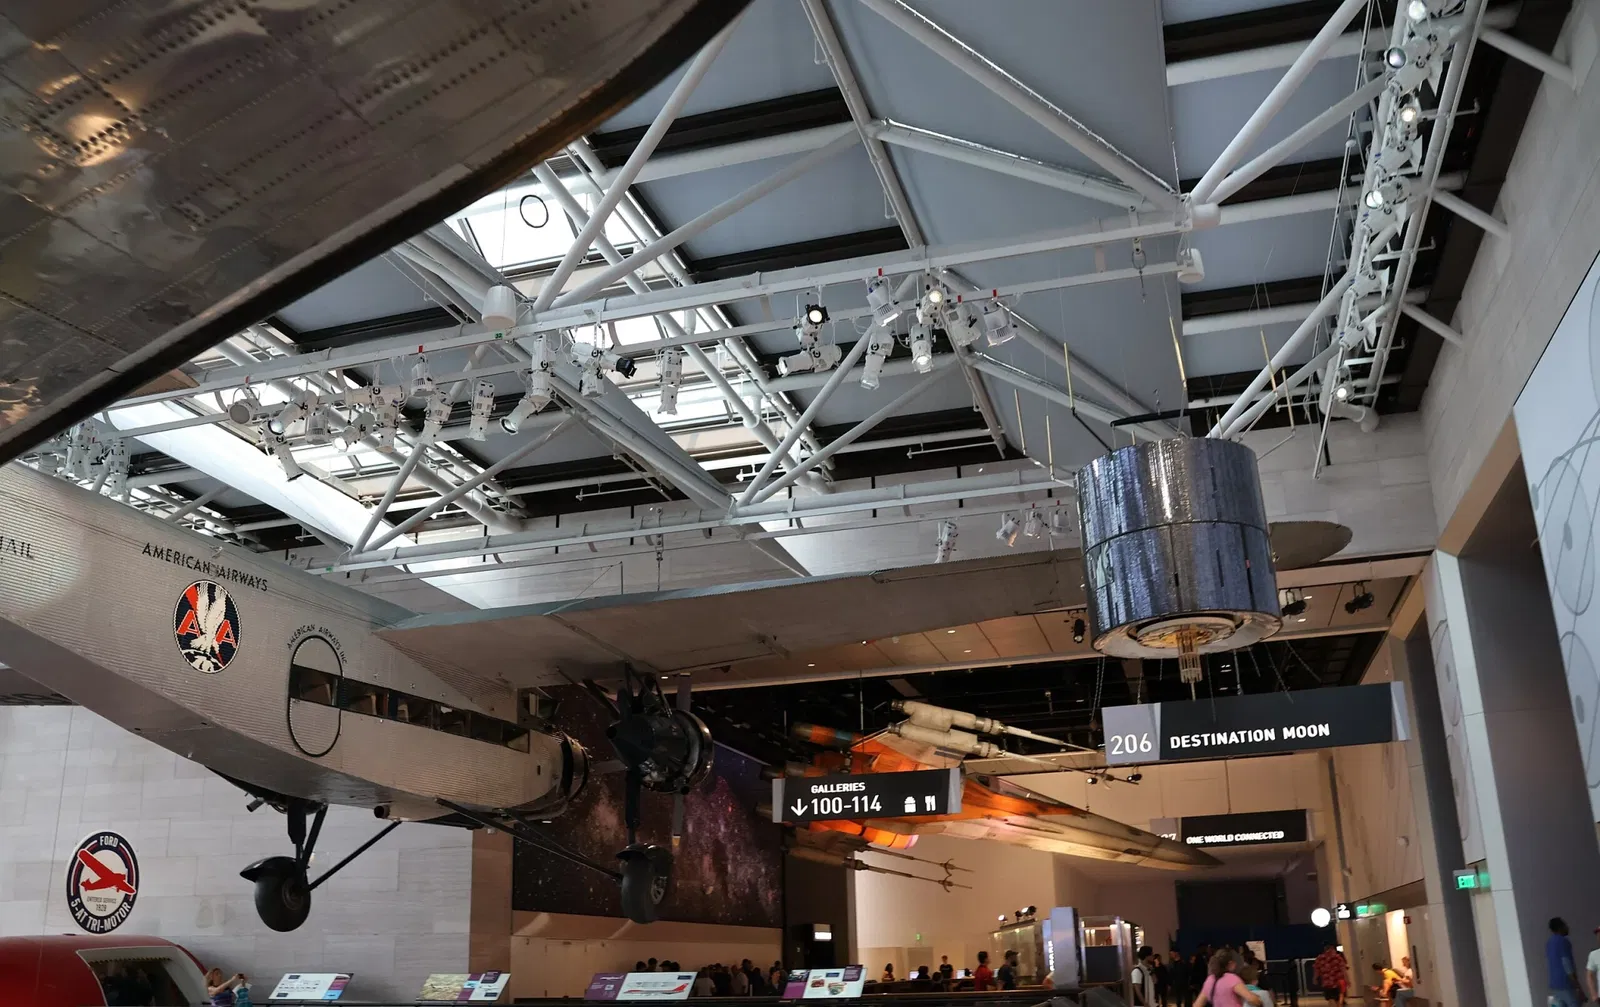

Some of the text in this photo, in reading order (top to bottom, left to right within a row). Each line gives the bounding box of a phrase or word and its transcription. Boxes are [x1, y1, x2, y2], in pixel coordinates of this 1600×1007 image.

[142, 542, 268, 591] AMERICAN AIRWAYS
[177, 609, 200, 637] A
[216, 619, 237, 648] A
[1110, 723, 1330, 755] 206 DESTINATION MOON
[811, 782, 866, 794] GALLERIES
[811, 795, 882, 815] 100-114
[99, 836, 119, 848] FORD
[1186, 836, 1205, 844] ONE
[1204, 833, 1234, 843] WORLD
[1234, 830, 1285, 842] CONNECTED
[71, 898, 131, 932] 5-AT TRI-MOTOR
